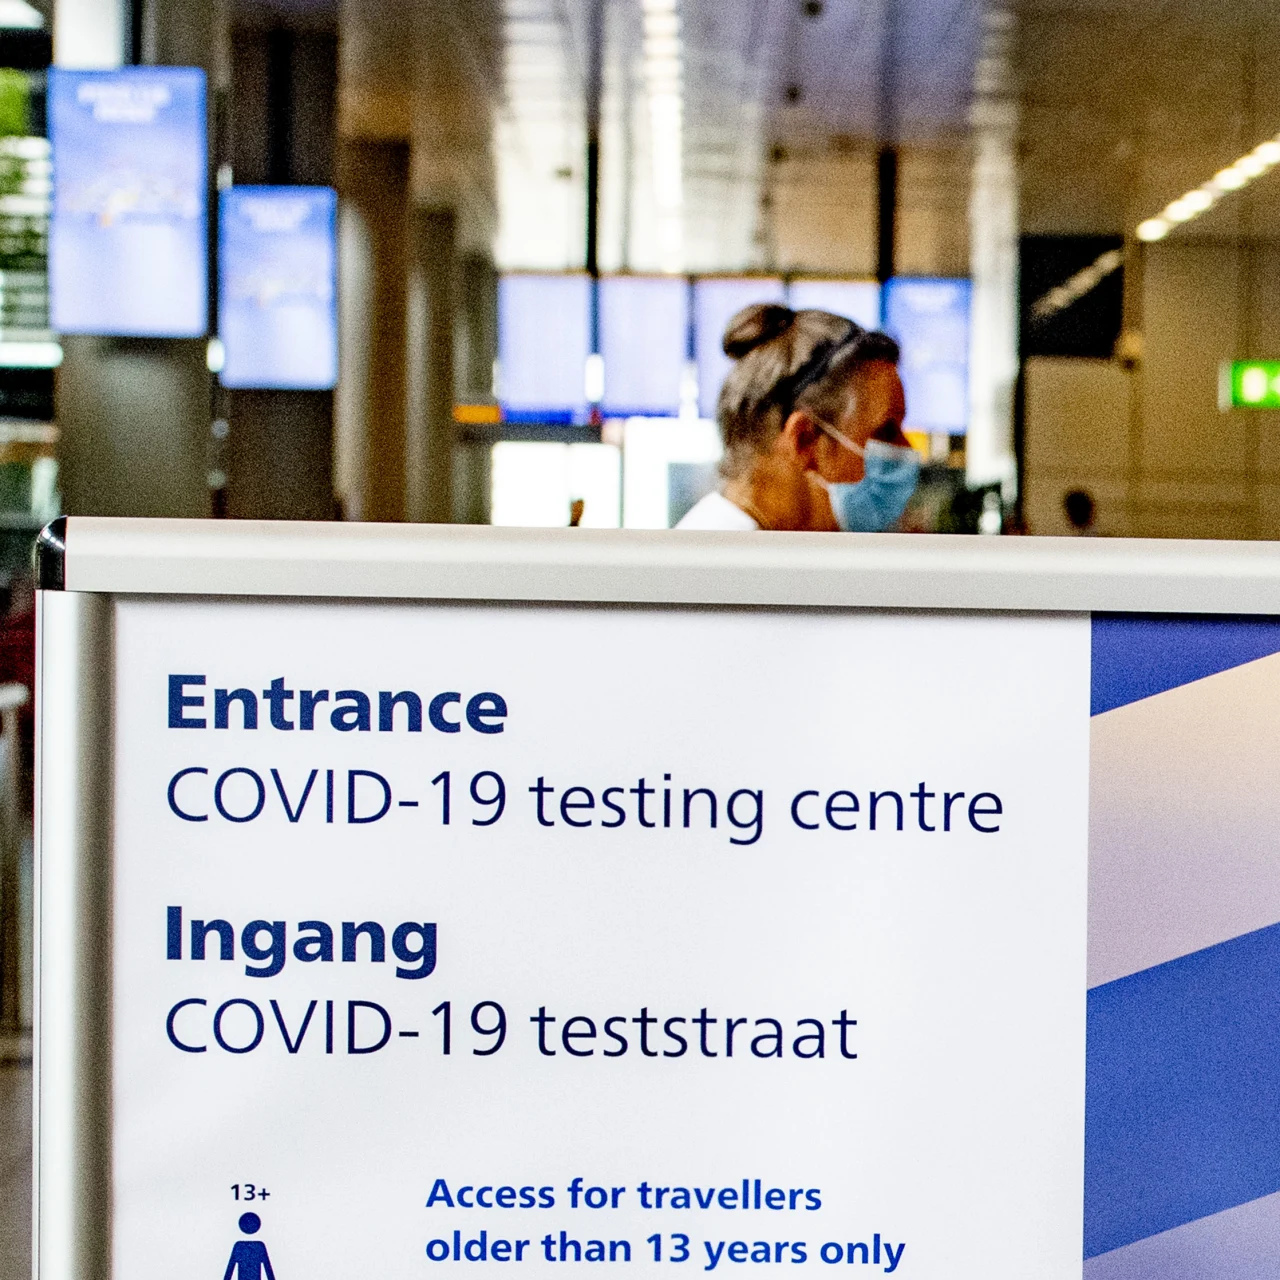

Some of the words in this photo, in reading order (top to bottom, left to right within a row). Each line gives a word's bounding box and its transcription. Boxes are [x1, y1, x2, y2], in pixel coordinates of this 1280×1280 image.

[167, 673, 508, 735] Entrance
[166, 766, 506, 827] COVID-19
[527, 772, 764, 846] testing
[790, 781, 1003, 834] centre
[166, 905, 438, 981] Ingang
[165, 997, 507, 1057] COVID-19
[529, 1005, 858, 1060] teststraat
[230, 1183, 271, 1202] 13+
[425, 1178, 556, 1209] Access
[566, 1176, 627, 1210] for
[636, 1178, 822, 1211] travellers
[425, 1229, 531, 1263] older
[540, 1230, 632, 1263] than
[646, 1232, 690, 1263] 13
[703, 1240, 808, 1272] years
[819, 1232, 906, 1274] only
